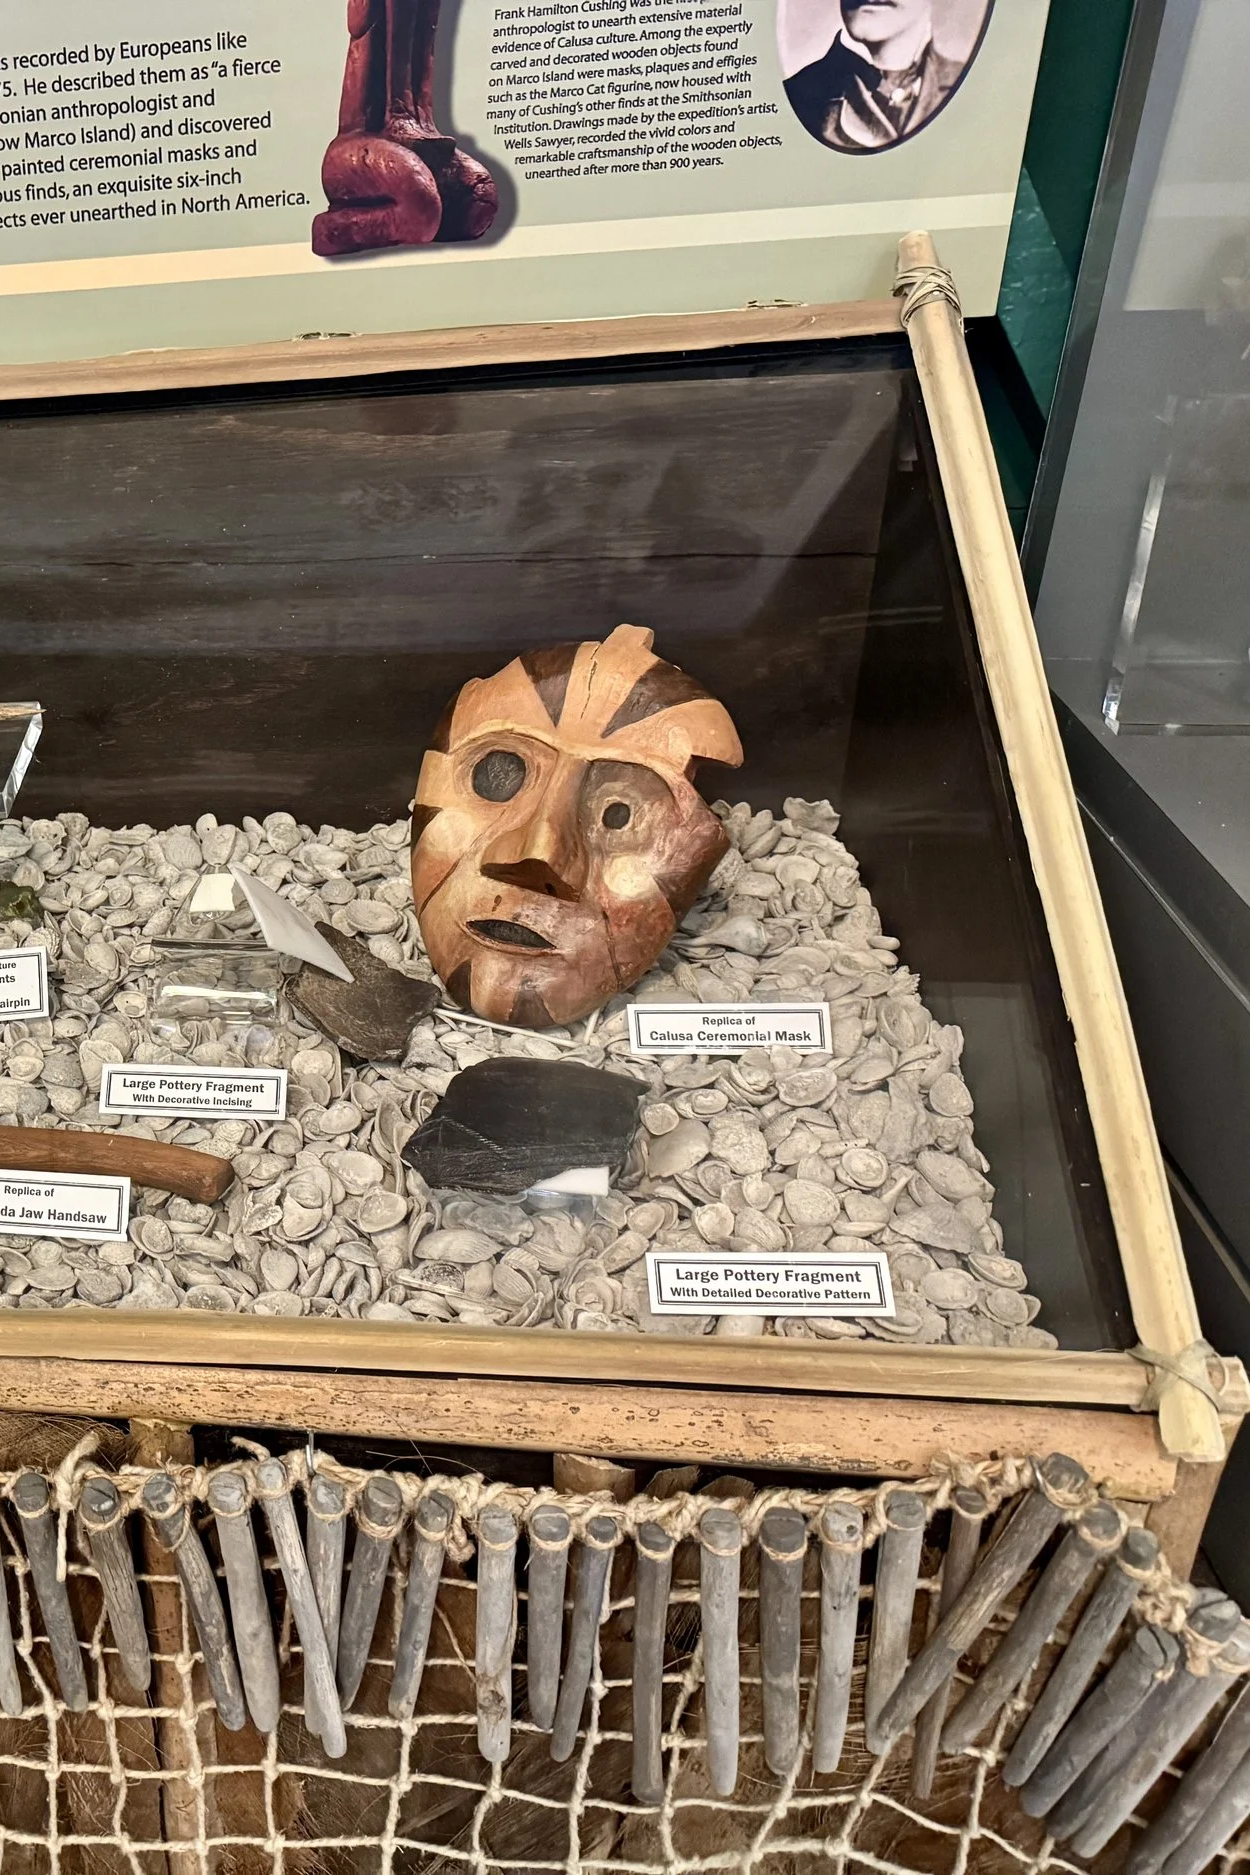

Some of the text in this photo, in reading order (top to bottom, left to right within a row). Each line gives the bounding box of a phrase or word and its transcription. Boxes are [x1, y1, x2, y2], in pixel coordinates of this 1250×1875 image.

[492, 20, 753, 54] evidence of Calusa culture. Among the expertly
[490, 38, 739, 71] carved and decorated wooden objects found
[489, 54, 757, 87] on Marco Island were masks, plaques and effigies
[25, 131, 76, 149] Marco
[81, 122, 136, 144] Island)
[141, 119, 173, 139] and
[178, 110, 271, 136] discovered
[515, 136, 782, 165] remarkable craftsmanship of the wooden objects,
[525, 157, 724, 180] unearthed after more than 900 years.
[25, 181, 70, 201] finds,
[73, 183, 93, 197] an
[98, 174, 173, 198] exquisite
[177, 167, 241, 189] six-inch
[702, 1016, 755, 1027] Replica of
[650, 1031, 811, 1041] Calusa Ceremonial Mask
[123, 1078, 264, 1094] Large Pottery Fragment
[133, 1093, 252, 1108] With Decorative Incising
[4, 1185, 54, 1197] Replica of
[19, 1208, 44, 1219] Jaw
[48, 1209, 107, 1224] Handsaw
[676, 1268, 862, 1285] Large Pottery Fragment
[670, 1287, 870, 1299] With Detailed Decorative Pattern
